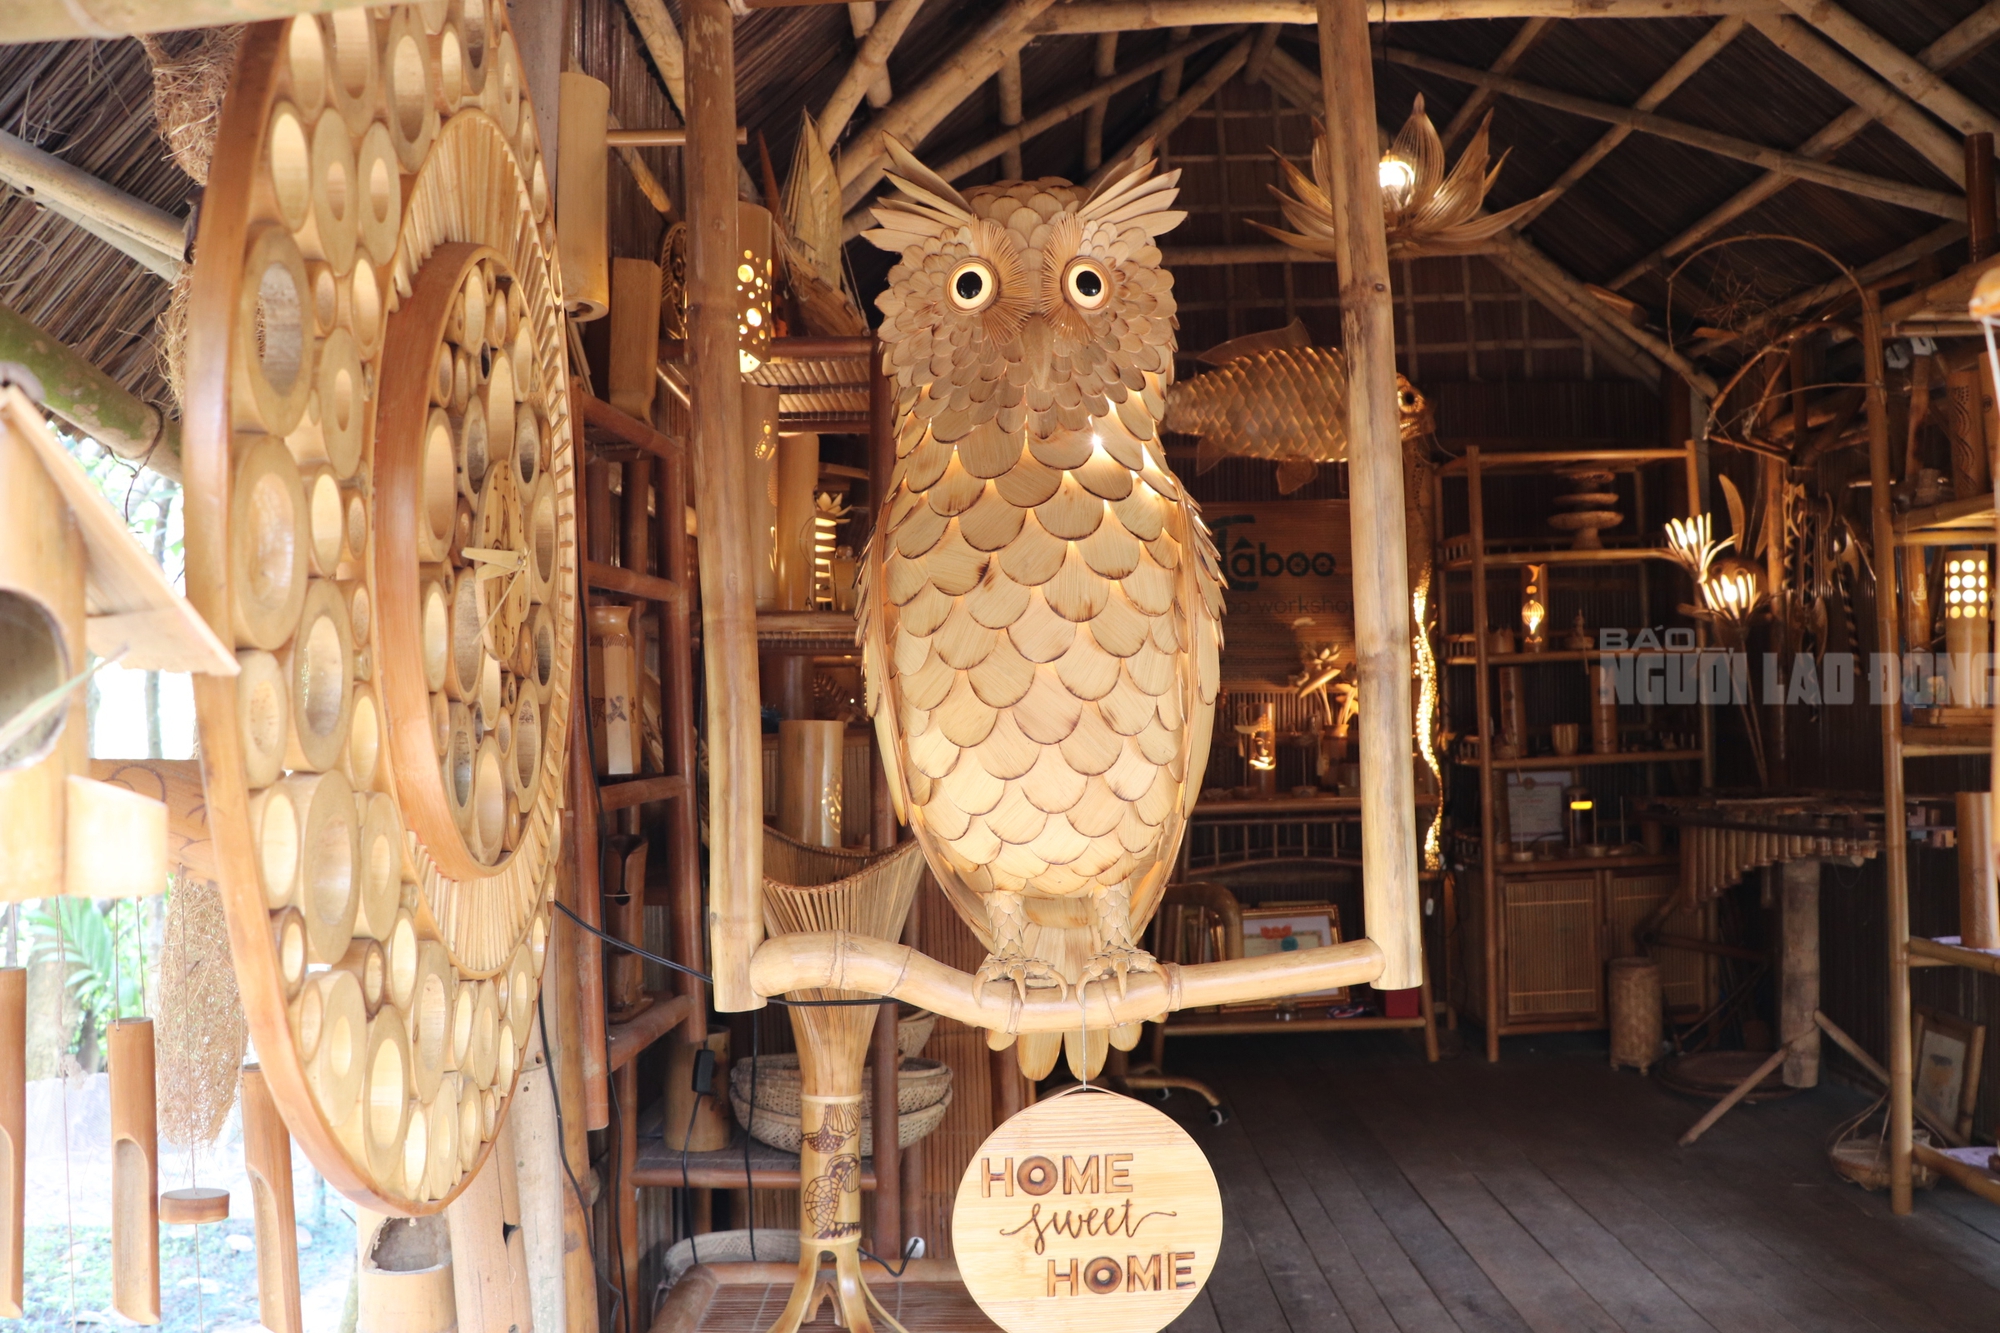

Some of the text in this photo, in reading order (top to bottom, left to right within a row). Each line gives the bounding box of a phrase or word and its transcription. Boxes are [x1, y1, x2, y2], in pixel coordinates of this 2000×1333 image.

[981, 1153, 1134, 1198] HOME
[1000, 1198, 1178, 1255] sweet
[1047, 1250, 1197, 1297] HOME
